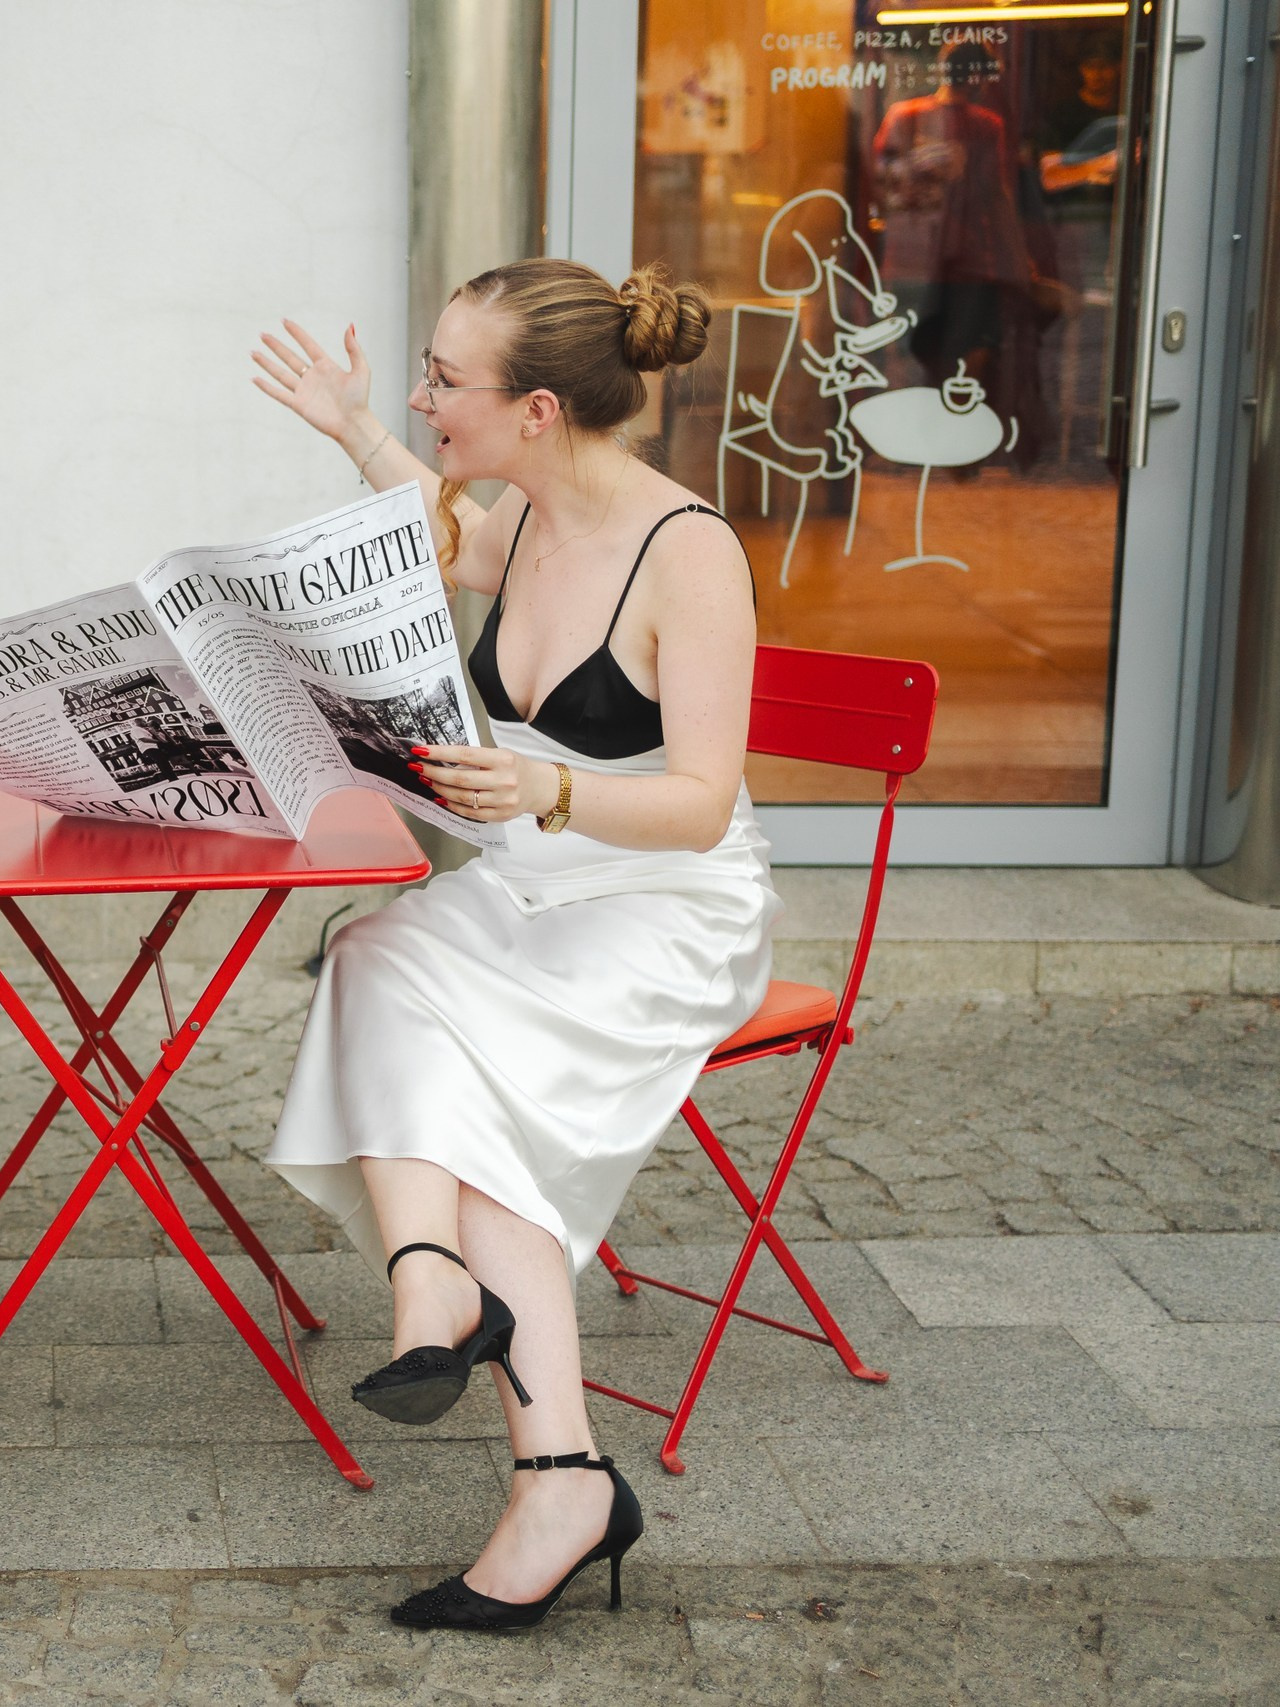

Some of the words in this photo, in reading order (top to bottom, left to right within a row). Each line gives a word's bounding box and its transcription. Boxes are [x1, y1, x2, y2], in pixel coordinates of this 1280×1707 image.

[760, 31, 842, 50] COFFEE,
[854, 30, 922, 49] PIZZA,
[928, 23, 1009, 45] ÉCLAIRS
[770, 61, 888, 93] PROGRAM
[155, 573, 213, 631] THE
[209, 572, 295, 612] LOVE
[299, 520, 431, 606] GAZETTE
[198, 611, 225, 628] 15/05
[321, 596, 383, 627] OFICIALĂ
[400, 581, 423, 598] 2027
[51, 630, 83, 655] &
[76, 609, 157, 648] RADU
[273, 639, 337, 676] SAVE
[337, 635, 389, 676] THE
[389, 607, 453, 664] DATE
[6, 677, 26, 693] &
[22, 666, 60, 686] MR.
[57, 646, 126, 675] GAVRIL
